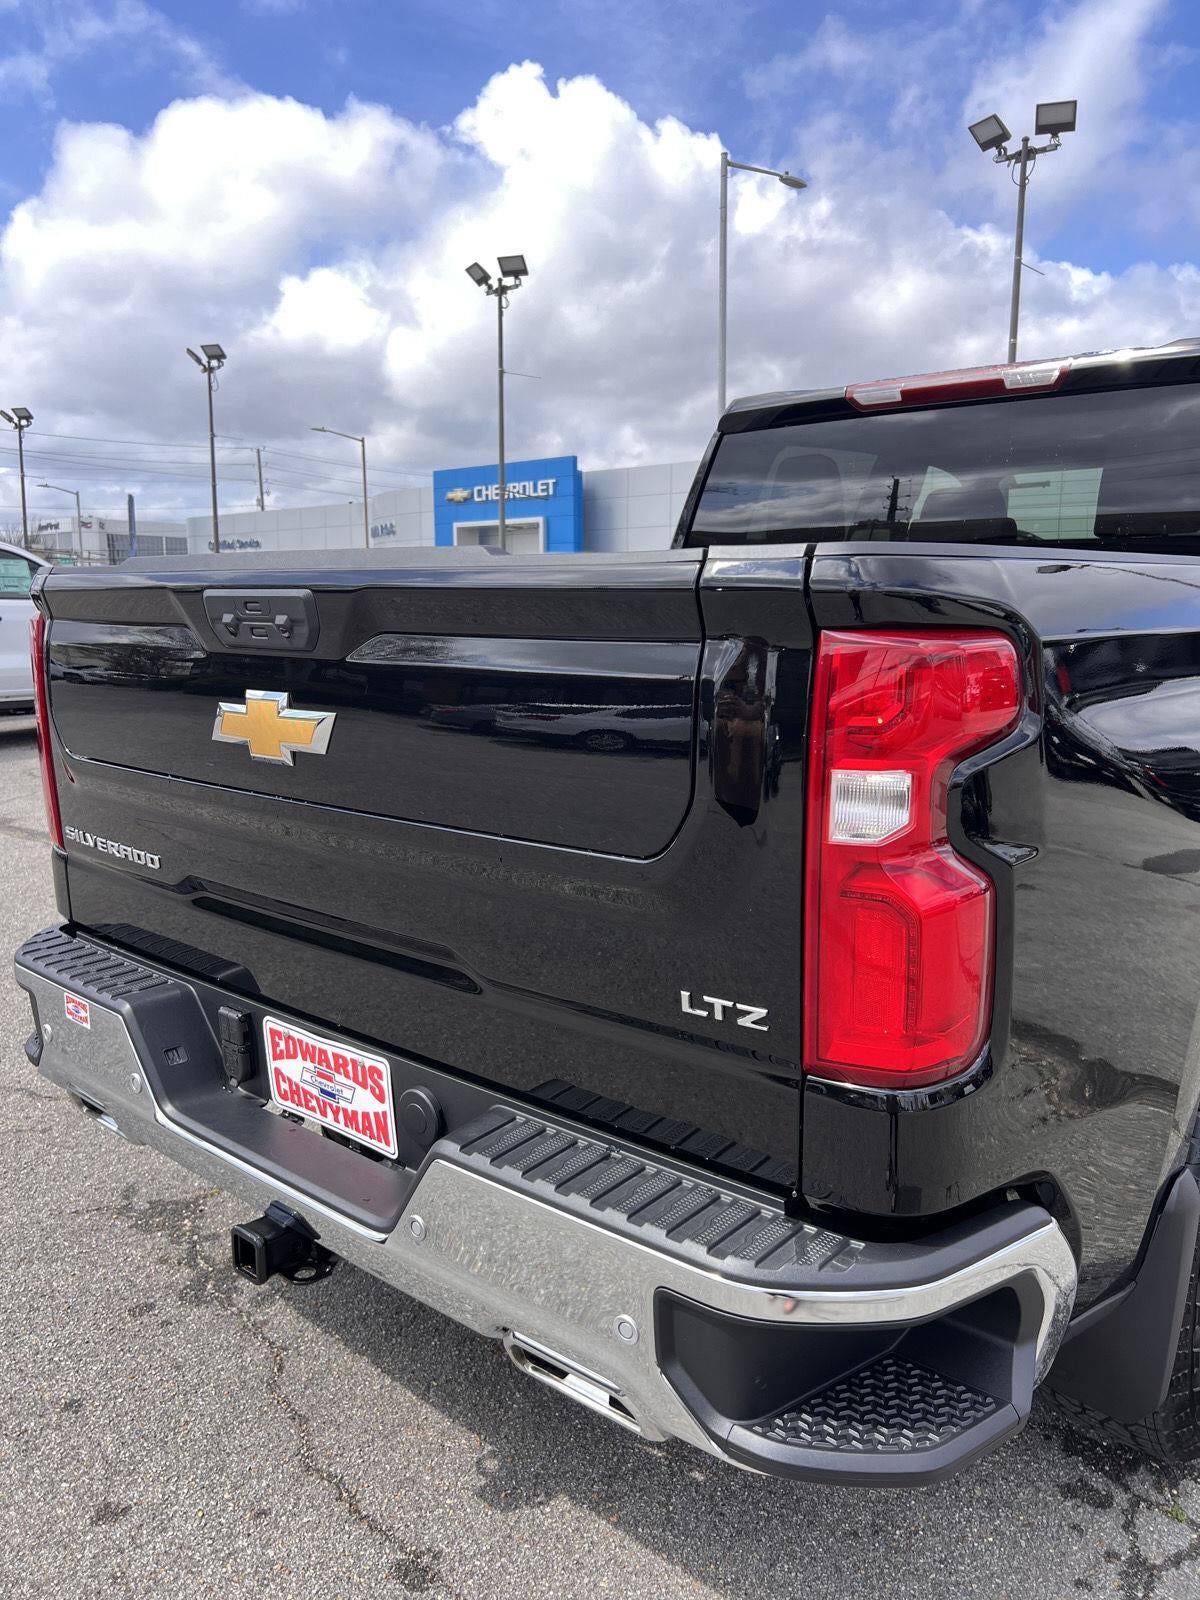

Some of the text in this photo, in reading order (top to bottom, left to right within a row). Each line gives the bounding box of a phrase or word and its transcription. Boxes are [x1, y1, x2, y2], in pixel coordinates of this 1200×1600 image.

[64, 825, 162, 870] SILVERADO
[680, 990, 770, 1032] LTZ
[268, 1027, 386, 1104] EDWARDS
[310, 1075, 344, 1096] Chevrolet
[273, 1066, 391, 1148] CHEVYMAN
